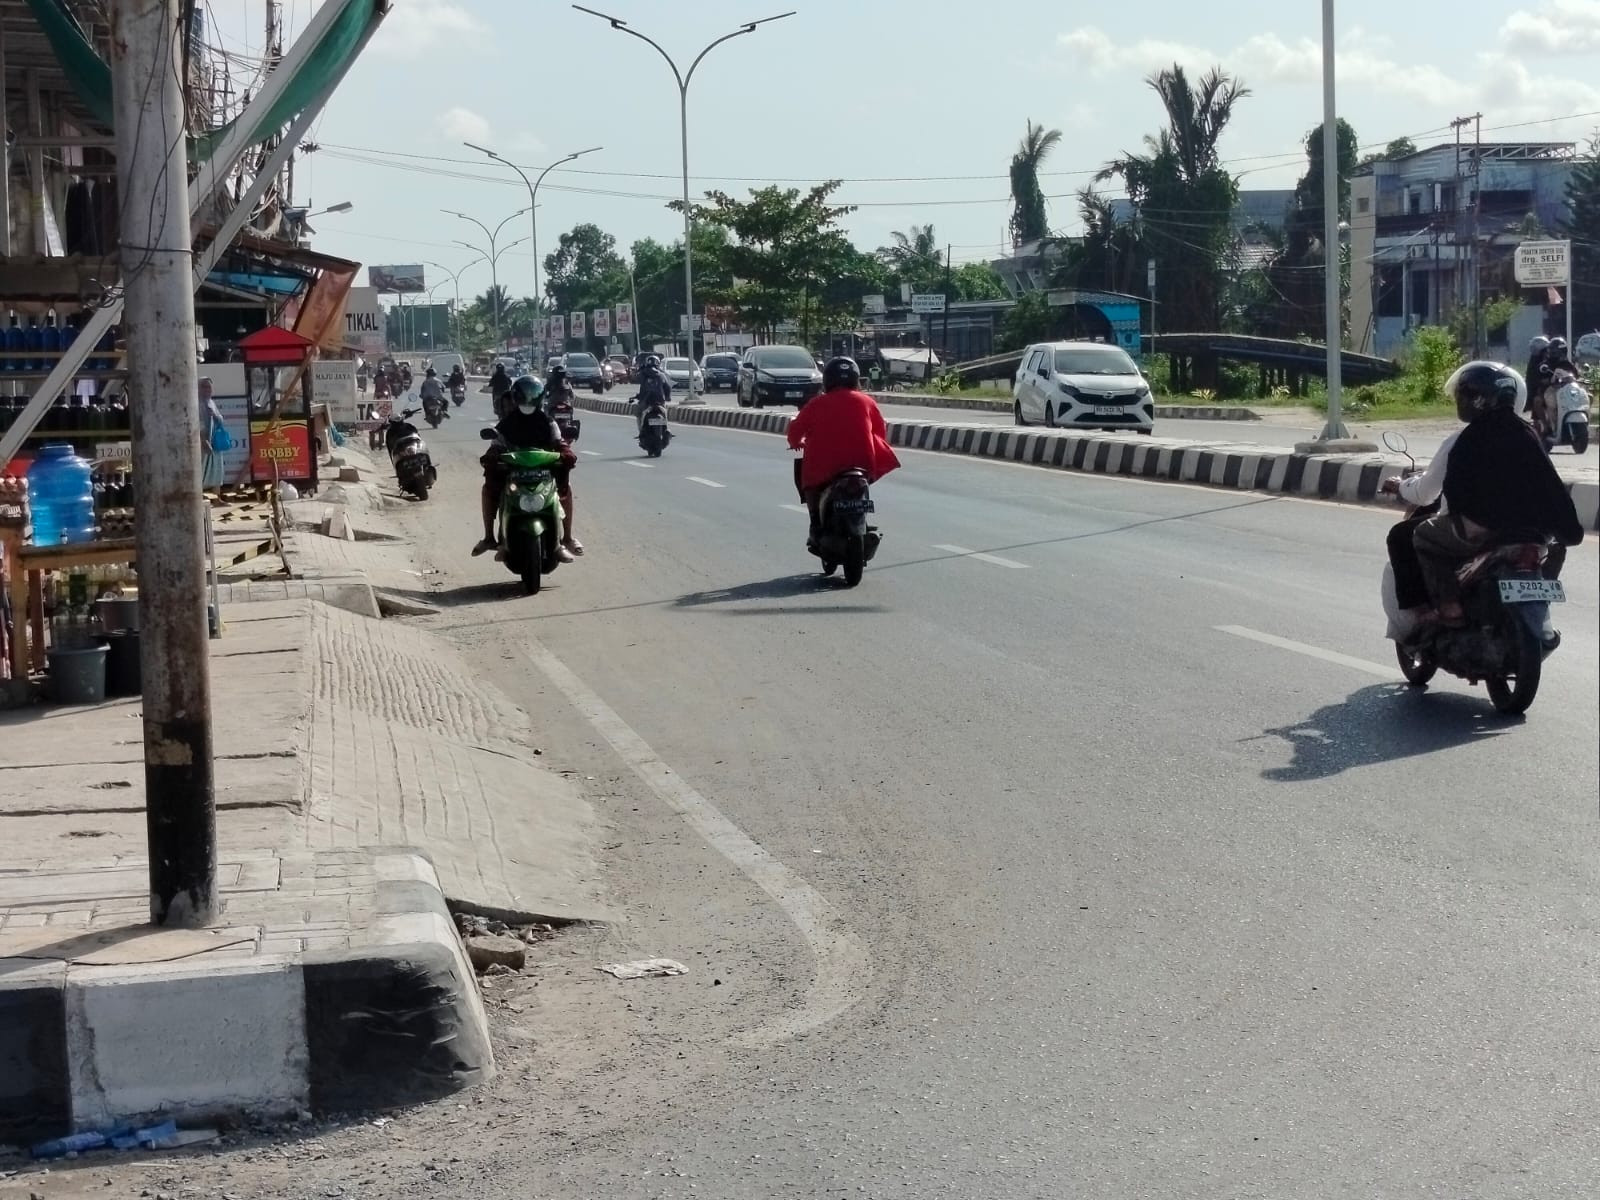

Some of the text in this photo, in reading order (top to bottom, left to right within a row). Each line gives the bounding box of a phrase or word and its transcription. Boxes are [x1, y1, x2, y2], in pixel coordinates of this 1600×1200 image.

[1540, 254, 1564, 262] SELFI
[345, 312, 379, 331] TIKAL
[356, 403, 376, 420] TA
[260, 446, 301, 458] BOBBY
[1500, 581, 1512, 591] DA
